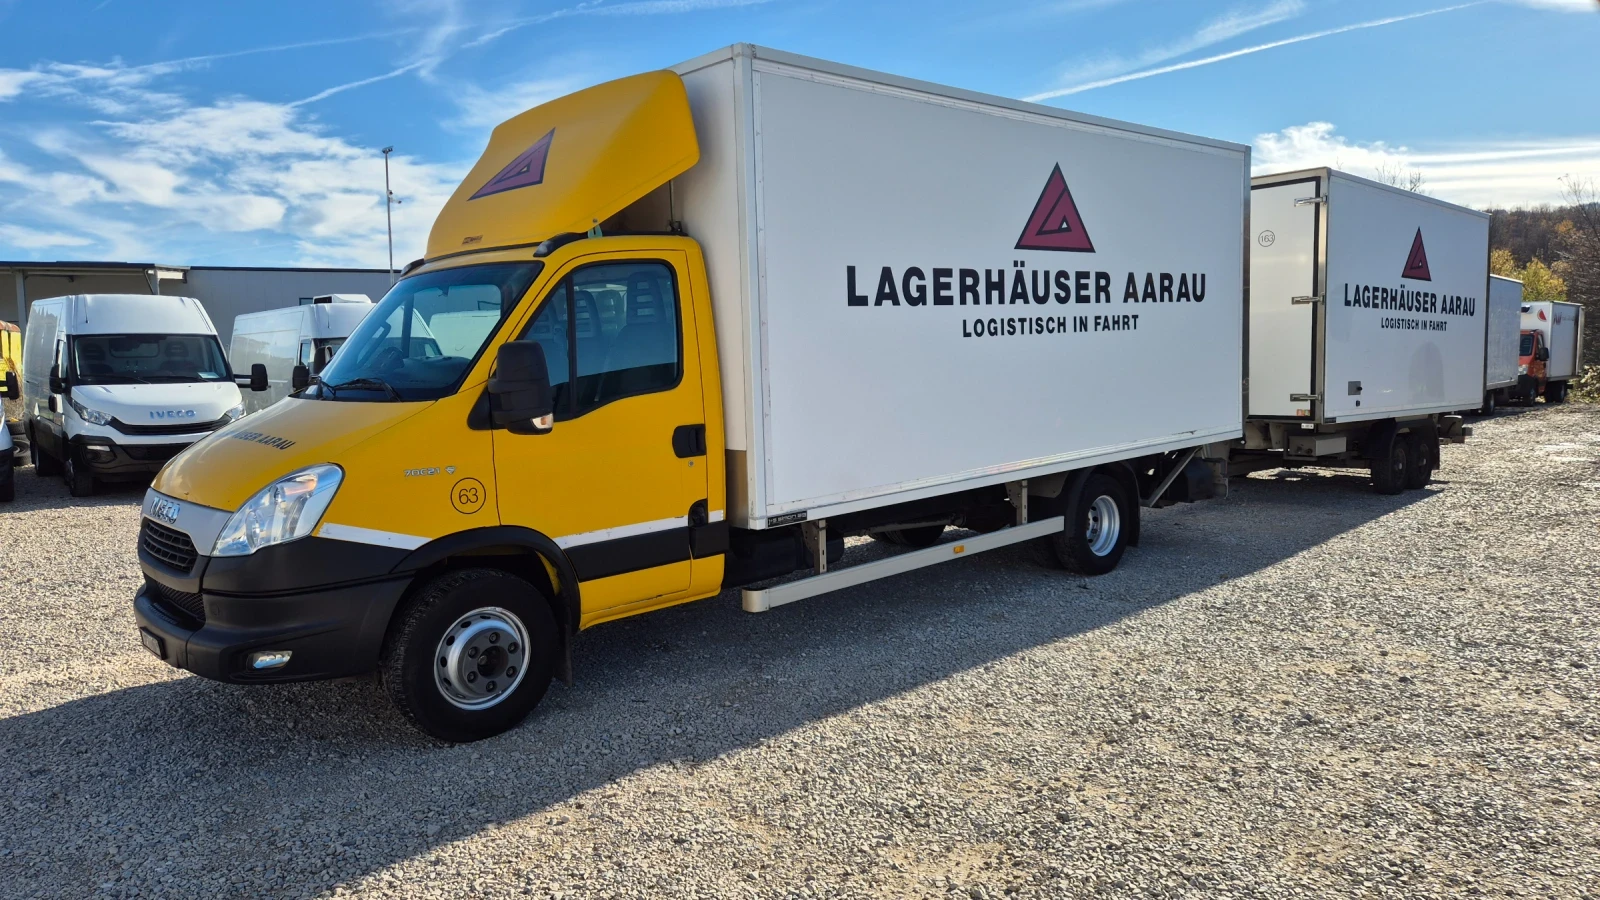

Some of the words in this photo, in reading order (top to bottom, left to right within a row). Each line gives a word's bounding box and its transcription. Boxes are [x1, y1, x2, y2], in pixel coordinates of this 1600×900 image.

[846, 260, 1112, 307] LAGERHÄUSER
[1122, 271, 1206, 304] AARAU
[1344, 283, 1437, 314] LAGERHÄUSER
[1440, 294, 1476, 317] AARAU
[962, 316, 1067, 338] LOGISTISCH
[1073, 315, 1089, 333] IN
[1094, 314, 1139, 331] FAHRT
[1381, 317, 1420, 330] LOGISTISCH
[1421, 319, 1428, 331] IN
[1429, 320, 1448, 332] FAHRT
[149, 409, 197, 419] IVECO
[458, 487, 479, 505] 63
